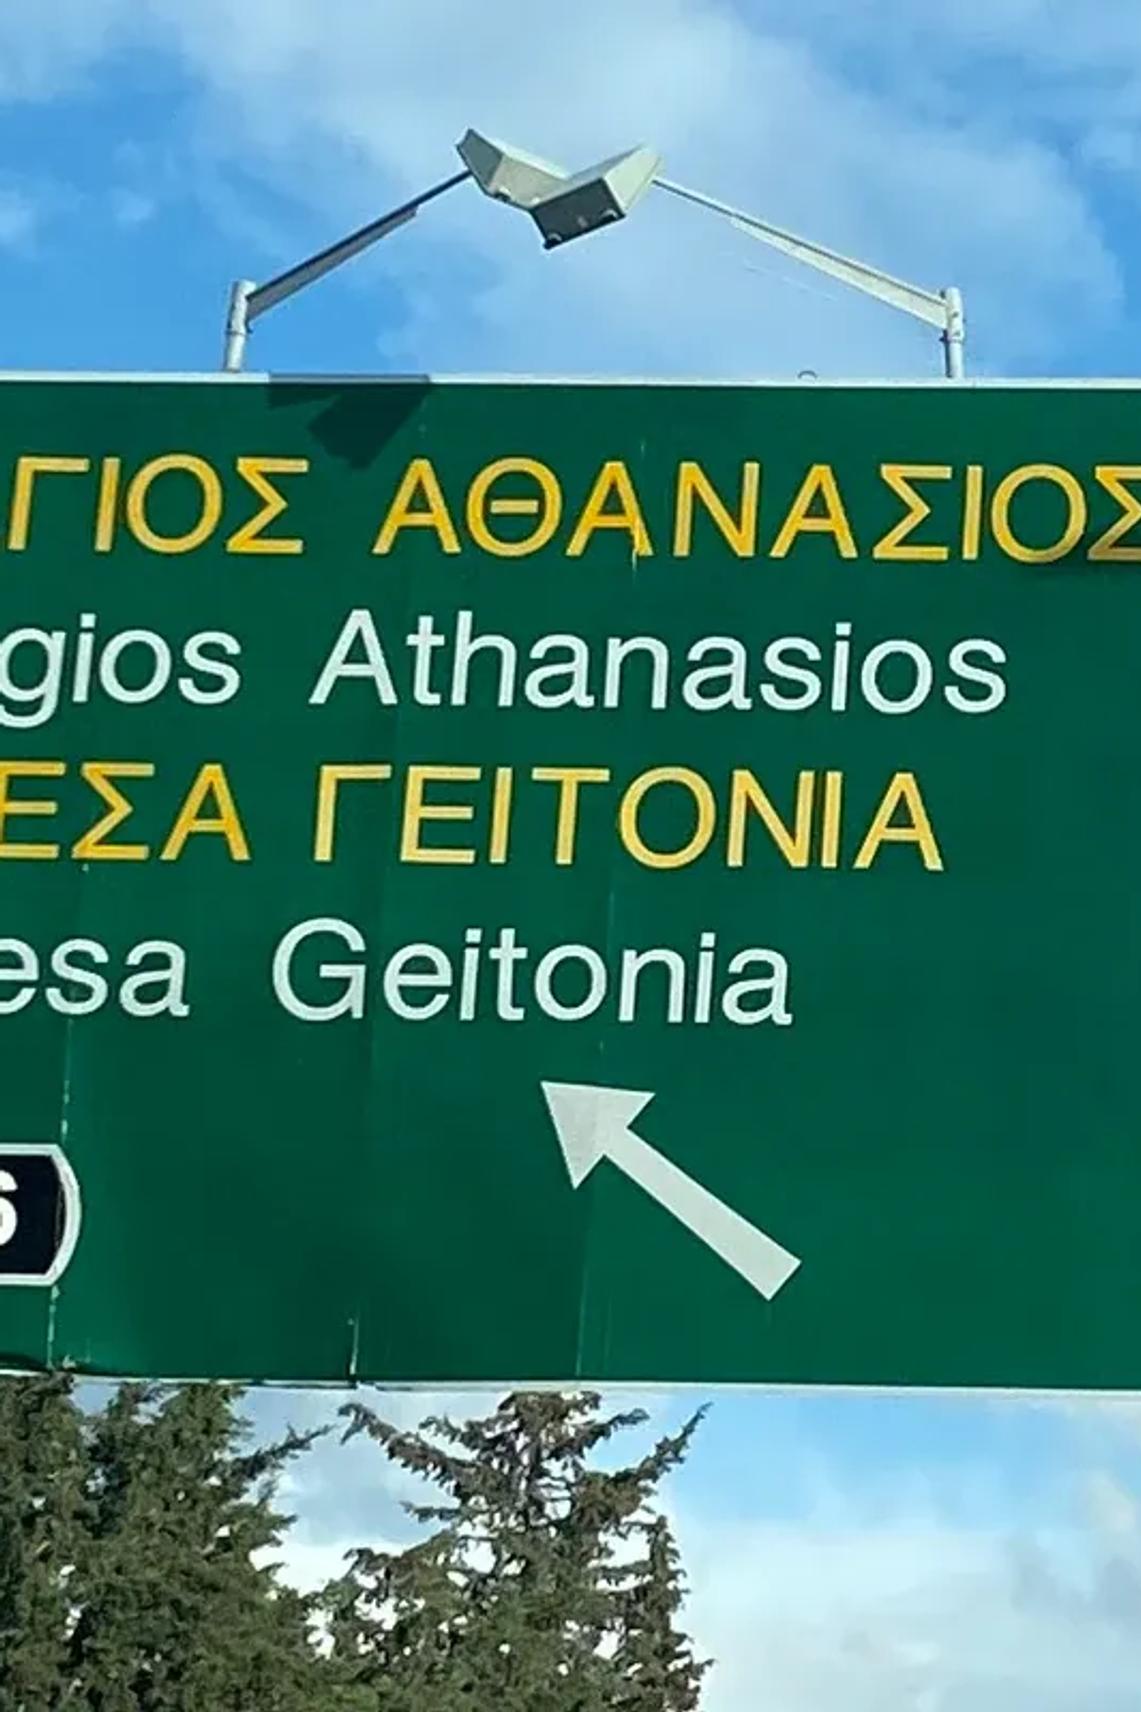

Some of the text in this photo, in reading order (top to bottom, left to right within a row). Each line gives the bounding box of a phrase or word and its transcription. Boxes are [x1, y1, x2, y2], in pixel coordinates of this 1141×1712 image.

[8, 454, 309, 554] ΓΙΟΣ
[0, 609, 1007, 728] gios Athanasios
[0, 760, 944, 871] ΕΣΑ ΓΕΙΤΟΝΙΑ
[272, 917, 793, 1026] Geitonia
